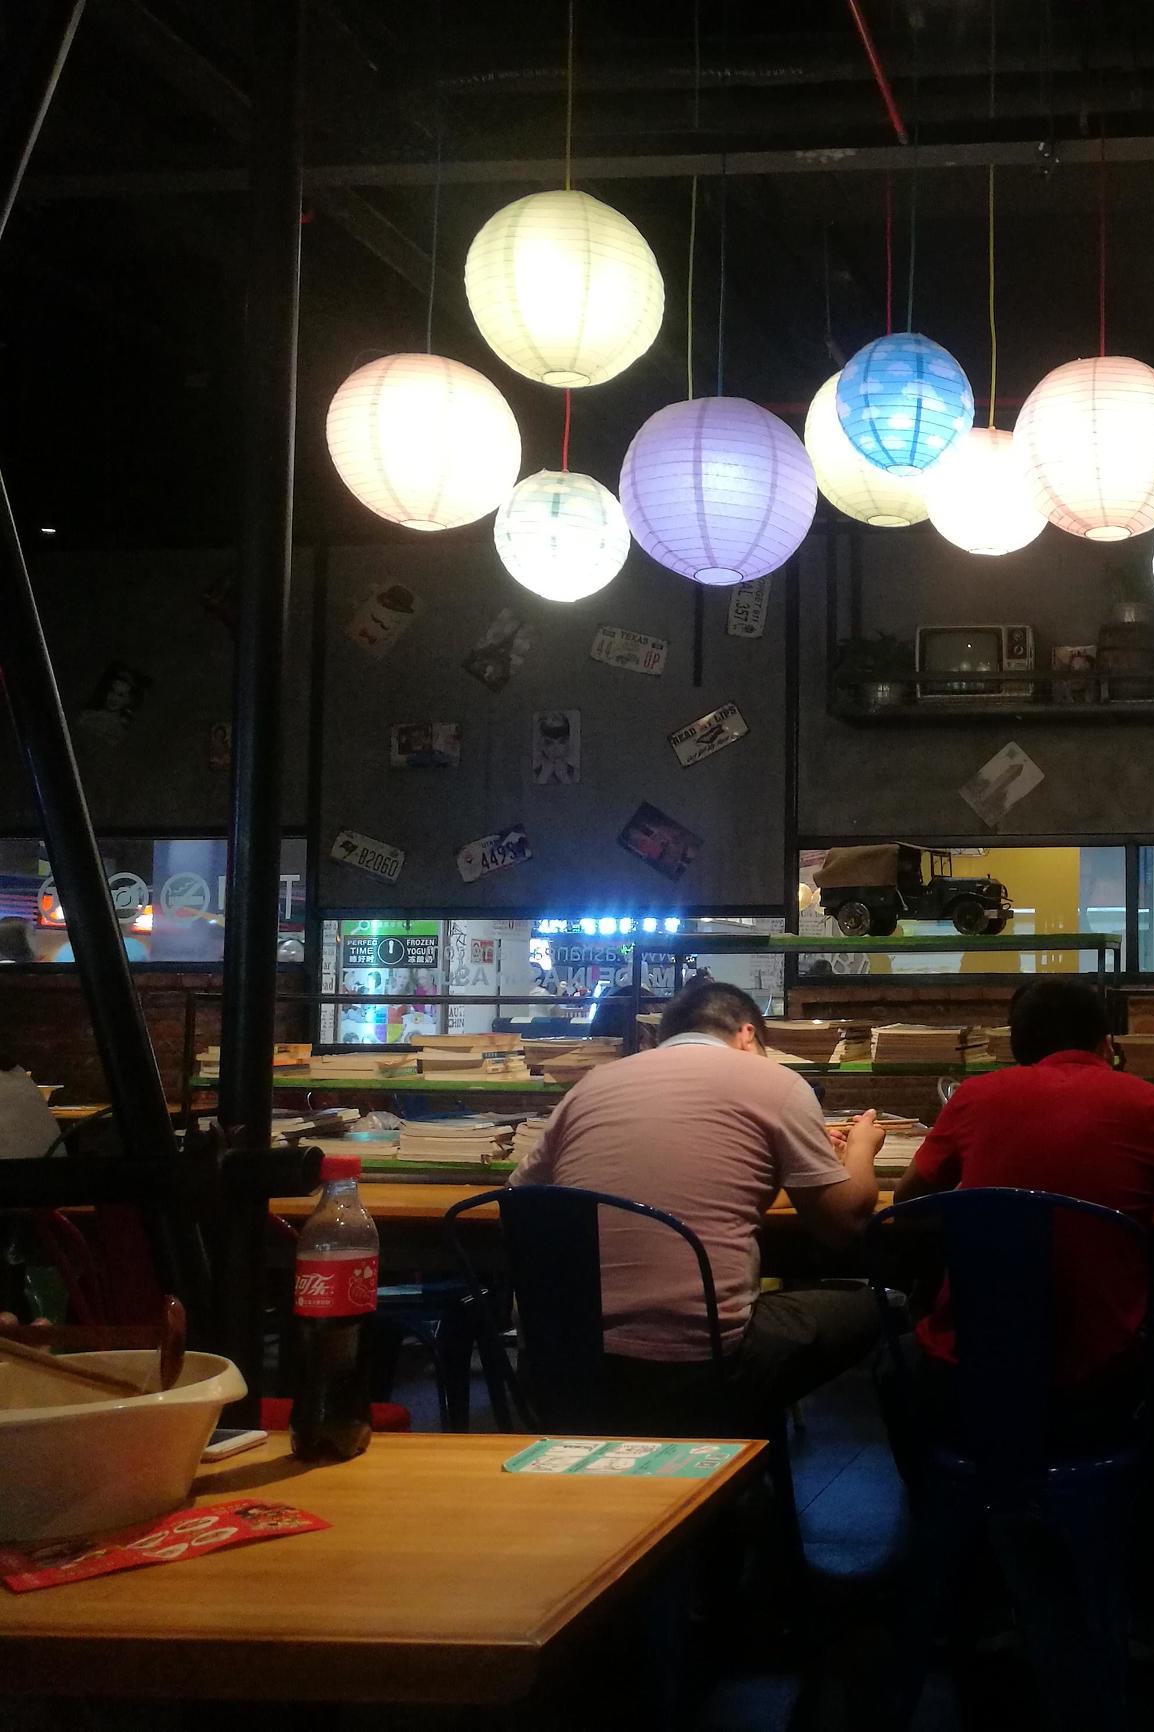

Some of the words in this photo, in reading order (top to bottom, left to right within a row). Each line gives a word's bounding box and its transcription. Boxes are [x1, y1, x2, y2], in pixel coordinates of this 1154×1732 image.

[620, 631, 649, 645] TEXAS
[713, 705, 737, 723] LIPS
[295, 1273, 335, 1296] 可乐
